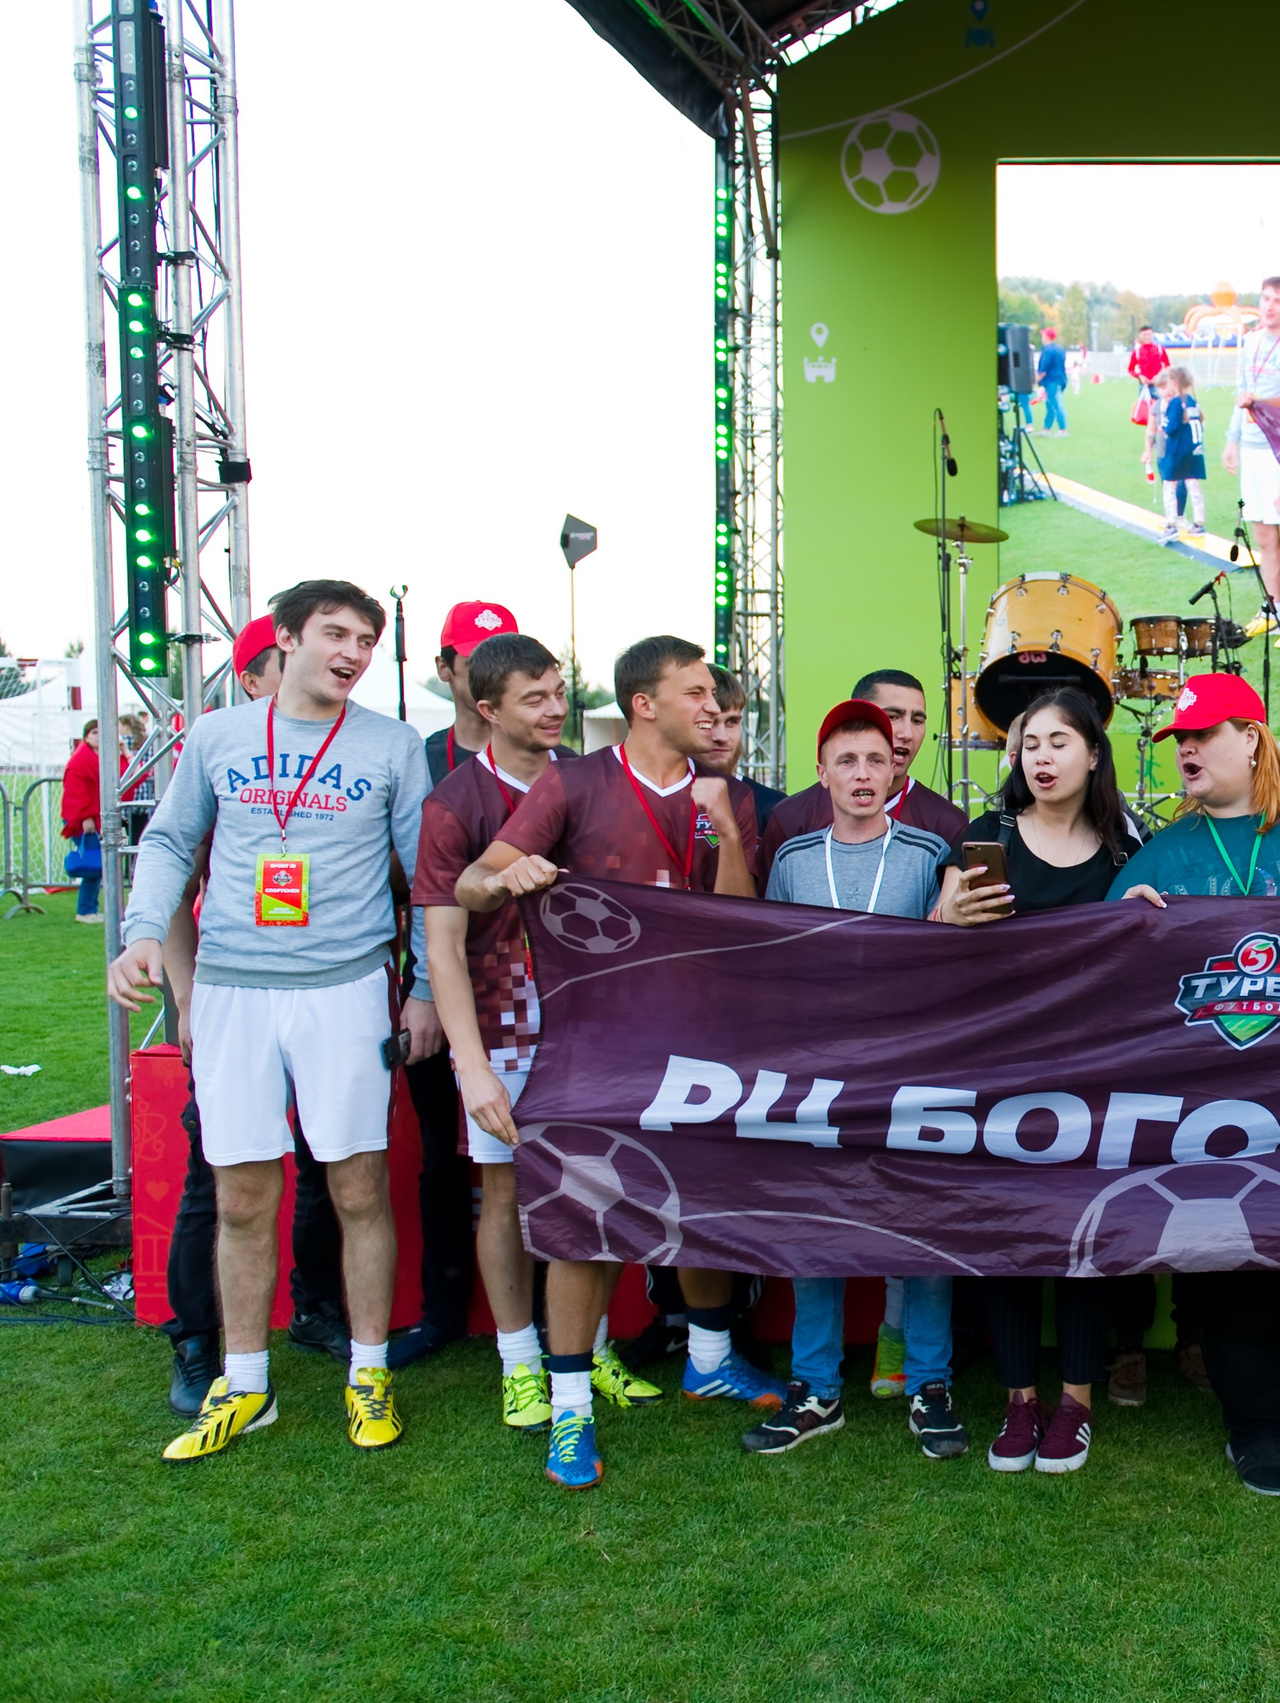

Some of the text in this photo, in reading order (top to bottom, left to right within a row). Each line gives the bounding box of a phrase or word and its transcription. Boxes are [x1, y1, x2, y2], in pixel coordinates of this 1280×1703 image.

[227, 753, 372, 801] ADIDAS
[240, 788, 347, 812] ORIGINALS
[251, 807, 334, 821] ESTALSHED 1972
[639, 1055, 844, 1148] РЦ
